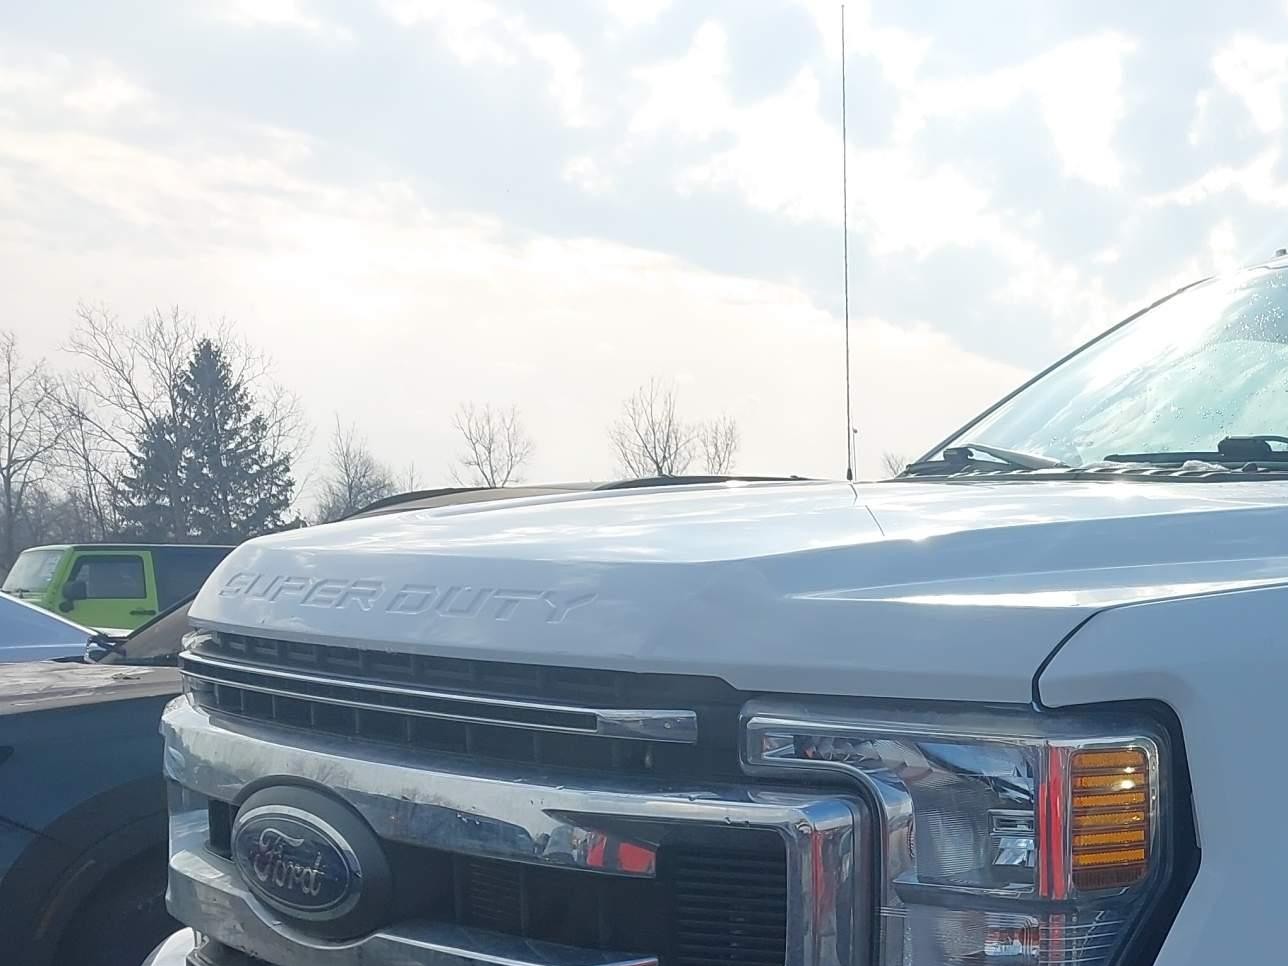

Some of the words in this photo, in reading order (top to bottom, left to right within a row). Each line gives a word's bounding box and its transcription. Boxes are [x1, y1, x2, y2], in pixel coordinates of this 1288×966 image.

[218, 571, 386, 612] SUPER
[385, 582, 600, 626] DUTY
[253, 827, 326, 897] Ford
